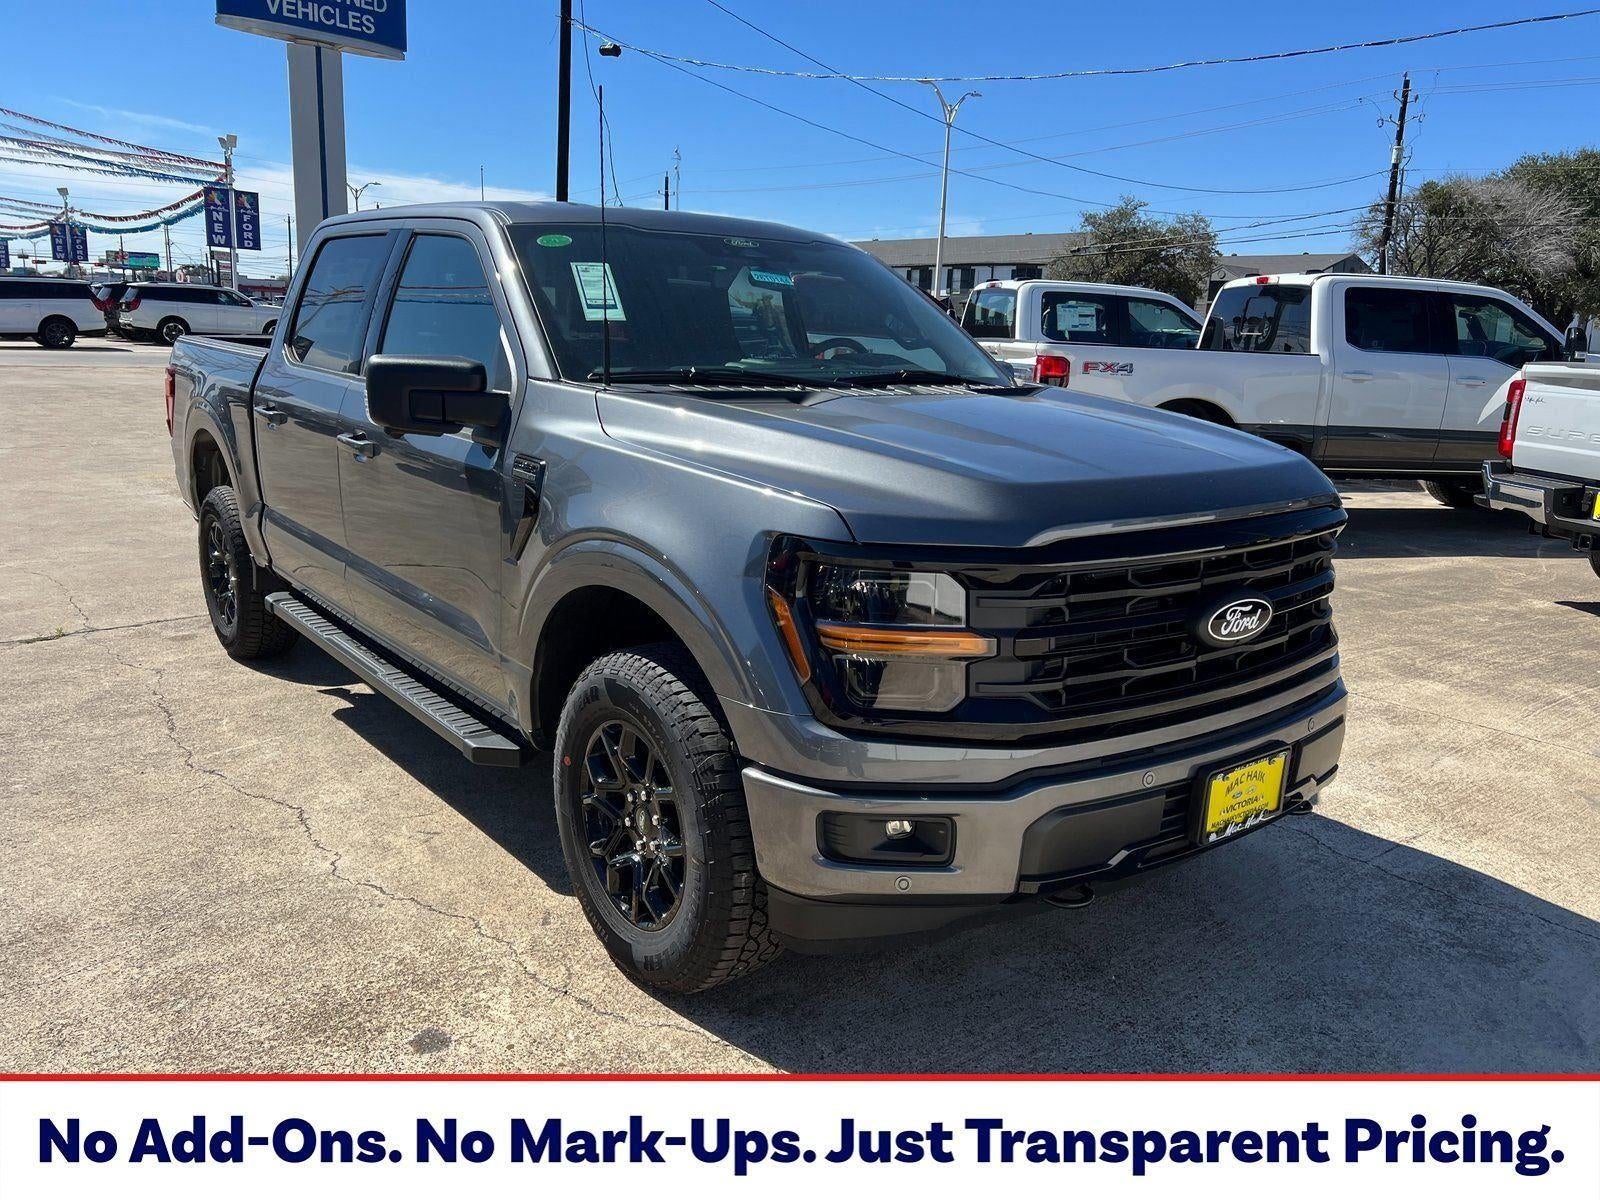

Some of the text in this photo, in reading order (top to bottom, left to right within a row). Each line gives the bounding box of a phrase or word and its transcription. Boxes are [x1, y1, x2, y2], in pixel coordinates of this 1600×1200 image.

[266, 0, 375, 34] VEHICLES
[212, 211, 226, 245] NEW
[242, 214, 254, 248] FORD
[55, 238, 65, 259] NEW
[1082, 361, 1134, 374] FX4
[1221, 605, 1262, 635] Ford
